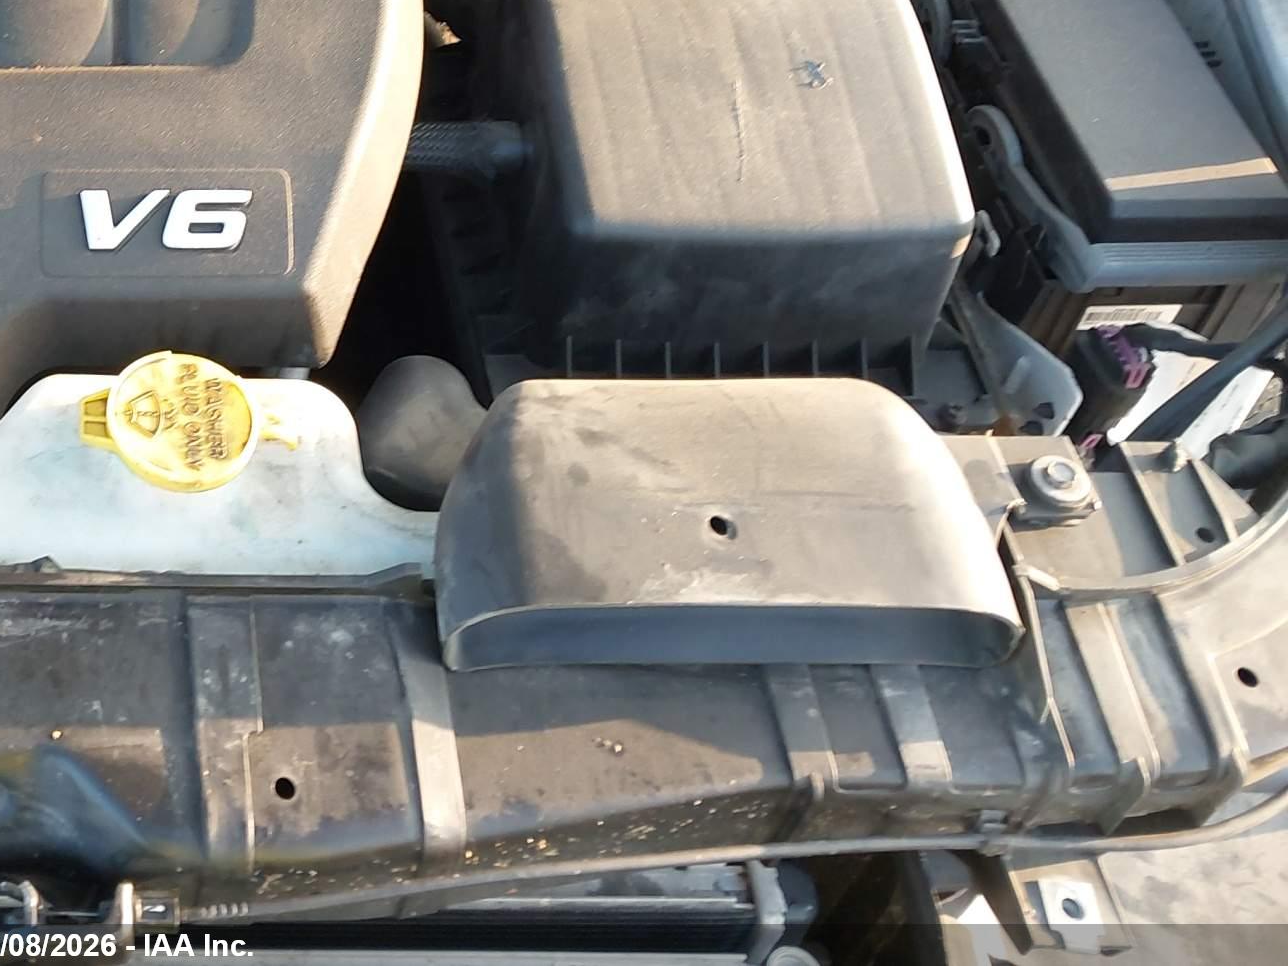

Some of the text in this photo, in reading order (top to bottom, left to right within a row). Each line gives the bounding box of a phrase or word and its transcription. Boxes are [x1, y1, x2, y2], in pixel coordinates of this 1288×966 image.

[79, 189, 253, 251] V6
[177, 363, 205, 471] FLUID ONLY
[205, 377, 228, 460] WASHER
